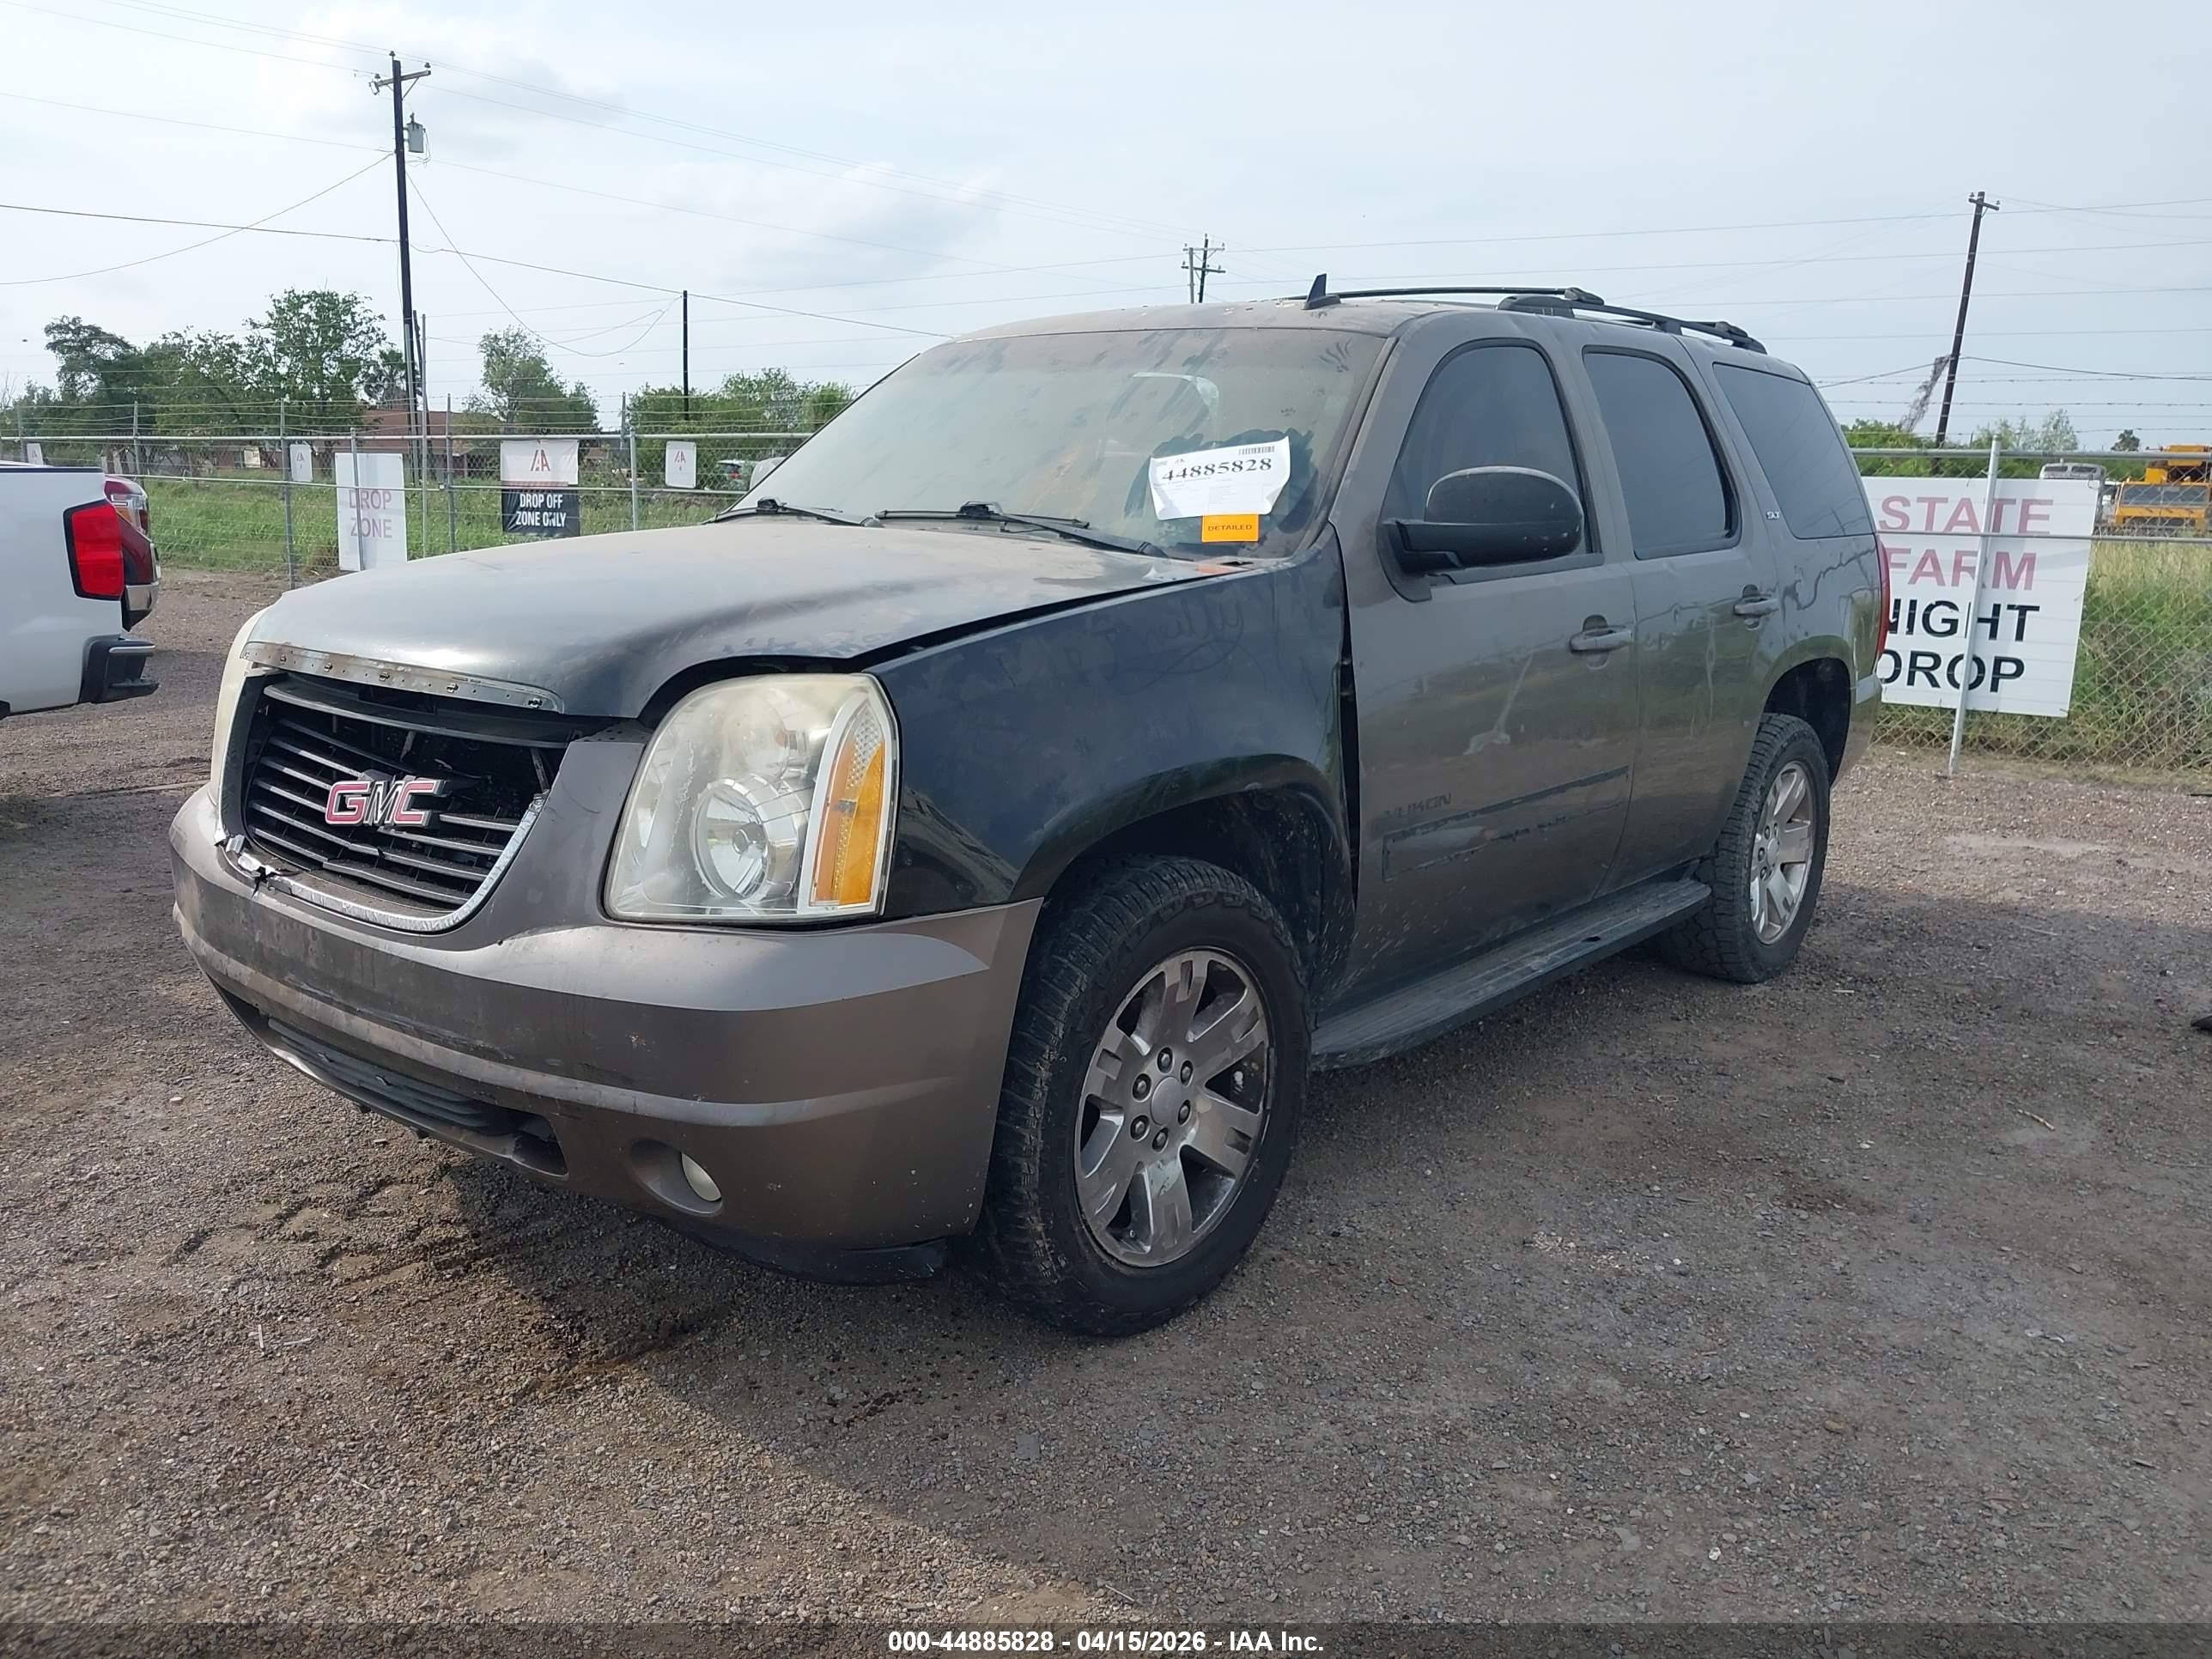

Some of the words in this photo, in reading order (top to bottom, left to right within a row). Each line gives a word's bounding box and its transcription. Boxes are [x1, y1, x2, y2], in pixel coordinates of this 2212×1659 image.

[1162, 457, 1273, 481] 44885828
[349, 489, 392, 509] DROP
[520, 493, 544, 508] DROP
[547, 493, 563, 509] OFF
[515, 510, 541, 526] ZONE
[543, 511, 567, 527] ONLY
[1878, 495, 2054, 535] STATE
[350, 517, 392, 538] ZONE
[1207, 524, 1253, 532] DETAILED
[1887, 546, 2038, 591] FARM
[325, 778, 441, 827] GMC
